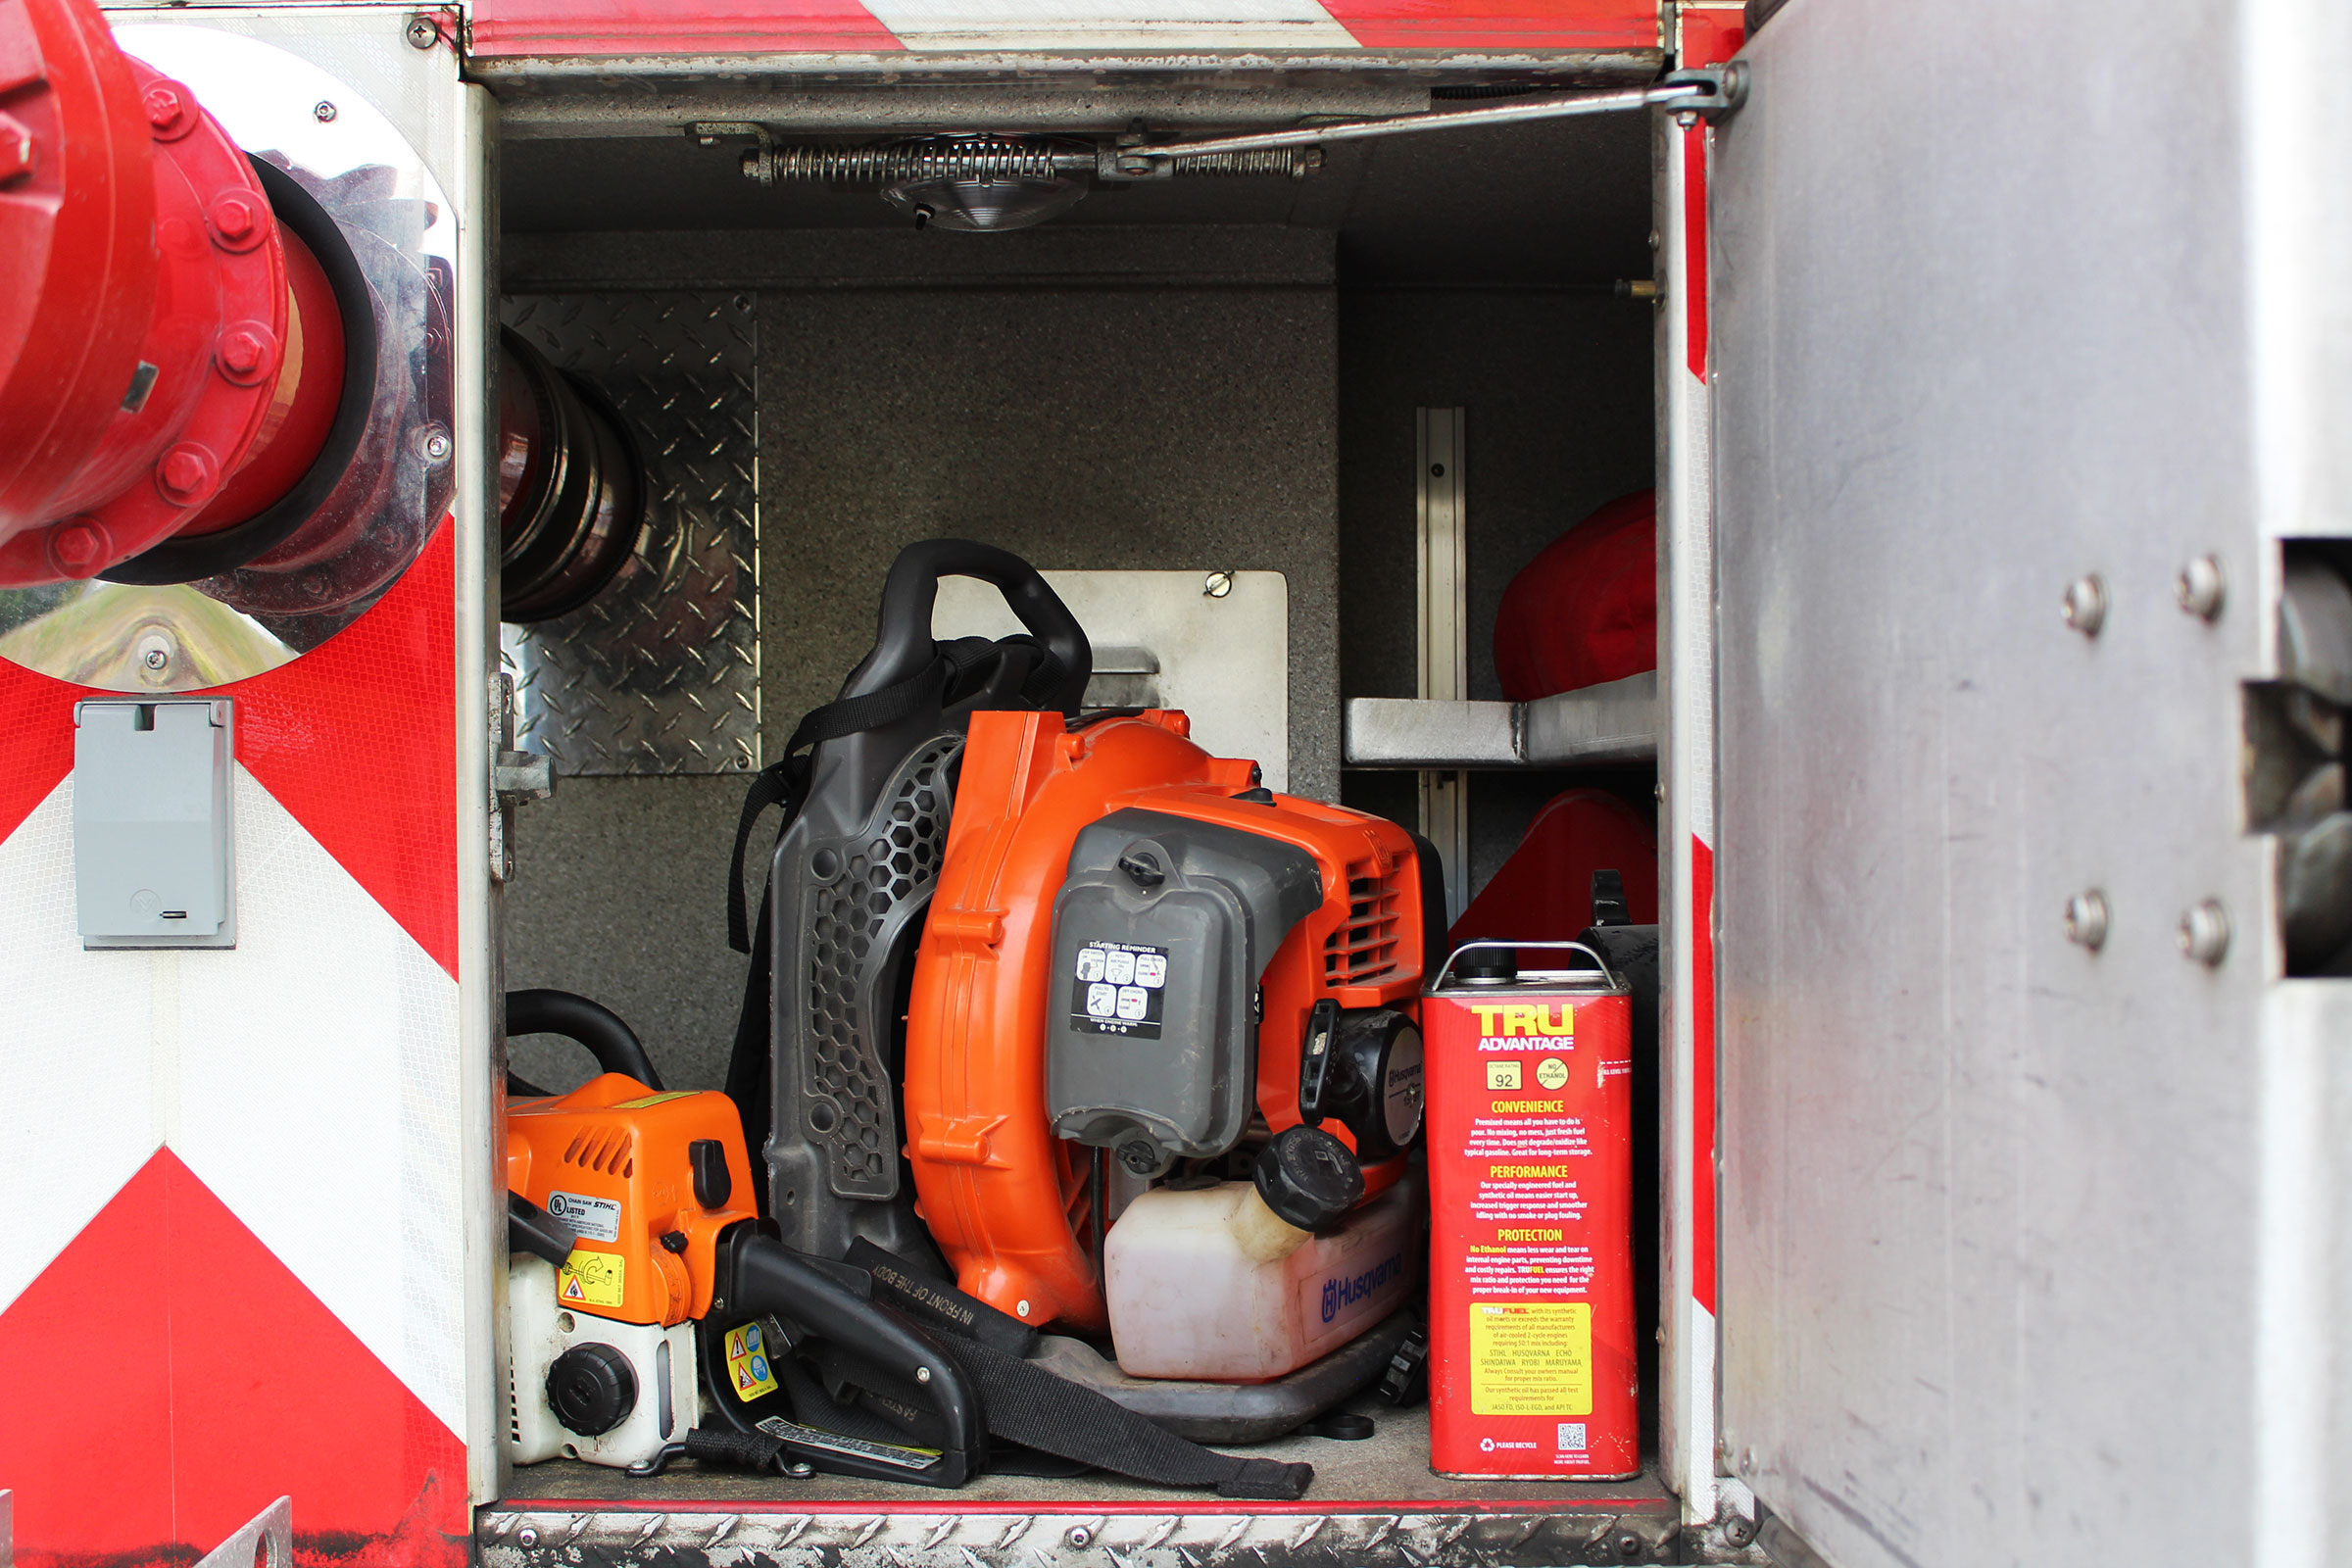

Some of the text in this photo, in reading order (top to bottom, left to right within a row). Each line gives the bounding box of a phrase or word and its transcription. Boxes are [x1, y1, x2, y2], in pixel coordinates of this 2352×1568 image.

[1089, 941, 1156, 953] STARTING REMINDER
[1471, 1004, 1574, 1036] TRU
[1478, 1037, 1574, 1051] ADVANTAGE
[1495, 1074, 1512, 1087] 92
[1492, 1100, 1564, 1113] CONVENIENCE
[1496, 1128, 1518, 1137] mixing,
[1545, 1128, 1556, 1137] just
[1464, 1148, 1484, 1157] typical
[1485, 1148, 1510, 1157] gasoline.
[1538, 1148, 1568, 1157] long-term
[1569, 1148, 1592, 1157] storage.
[1490, 1165, 1568, 1178] PERFORMANCE
[1492, 1181, 1517, 1190] specially
[1518, 1181, 1551, 1190] engineered
[593, 1201, 615, 1210] STIHL
[1499, 1202, 1519, 1210] trigger
[566, 1207, 585, 1216] LISTED
[1476, 1212, 1493, 1220] idling
[1545, 1212, 1558, 1220] plug
[1559, 1212, 1582, 1220] fouling.
[1498, 1229, 1562, 1241] PROTECTION
[1490, 1256, 1510, 1264] engine
[1530, 1256, 1561, 1264] preventing
[1477, 1266, 1494, 1274] costly
[1495, 1266, 1516, 1274] repairs.
[1580, 1266, 1594, 1274] right
[1338, 1252, 1402, 1310] Husqvarna
[1510, 1276, 1540, 1285] protection
[872, 1263, 974, 1326] IN FRONT OF THE BODY
[1553, 1286, 1587, 1295] equipment.
